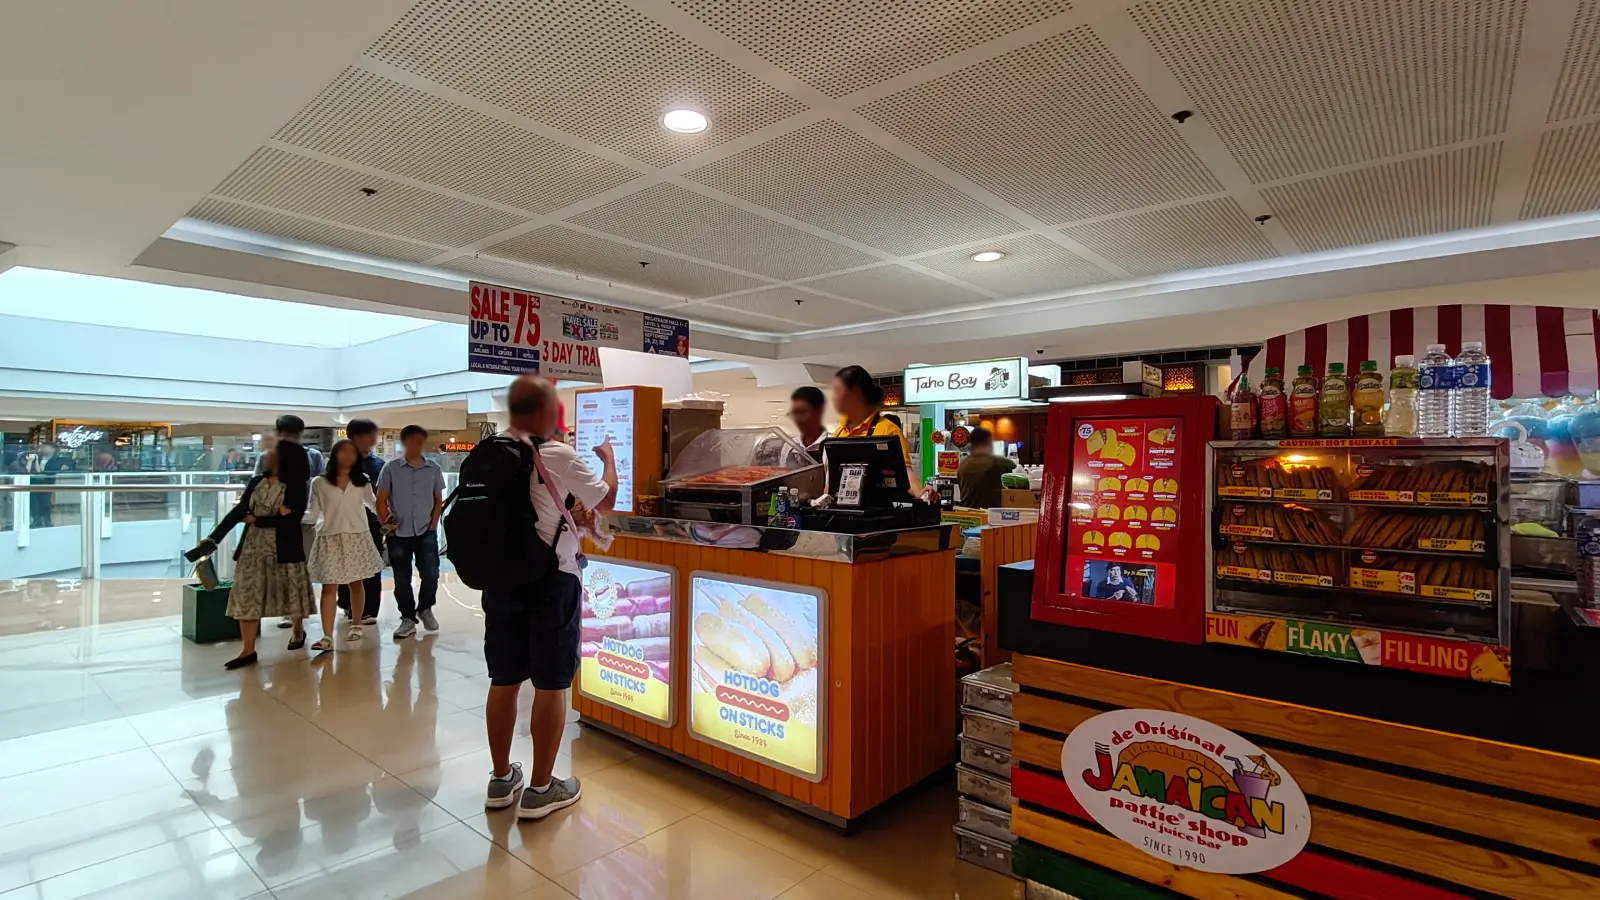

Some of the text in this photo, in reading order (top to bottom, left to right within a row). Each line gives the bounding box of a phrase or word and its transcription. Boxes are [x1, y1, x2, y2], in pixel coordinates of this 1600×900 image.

[470, 285, 510, 323] SALE
[470, 320, 510, 344] UP TO
[563, 314, 598, 328] TRAVEL SALE
[542, 340, 549, 362] 3
[552, 342, 573, 364] DAY
[910, 373, 978, 394] Taho Boy
[845, 490, 858, 498] BIR
[1205, 616, 1239, 639] FUN
[1288, 626, 1350, 656] FLAKY
[603, 638, 644, 661] HOTDOG
[1384, 638, 1469, 672] FILLING
[600, 669, 646, 695] ON STICKS
[724, 669, 780, 698] HOTDOG
[719, 706, 786, 740] ON STICKS
[1111, 720, 1228, 758] de Original
[1132, 815, 1222, 851] and juice bar
[1188, 818, 1249, 847] shop
[1143, 836, 1206, 864] SINCE 1990
